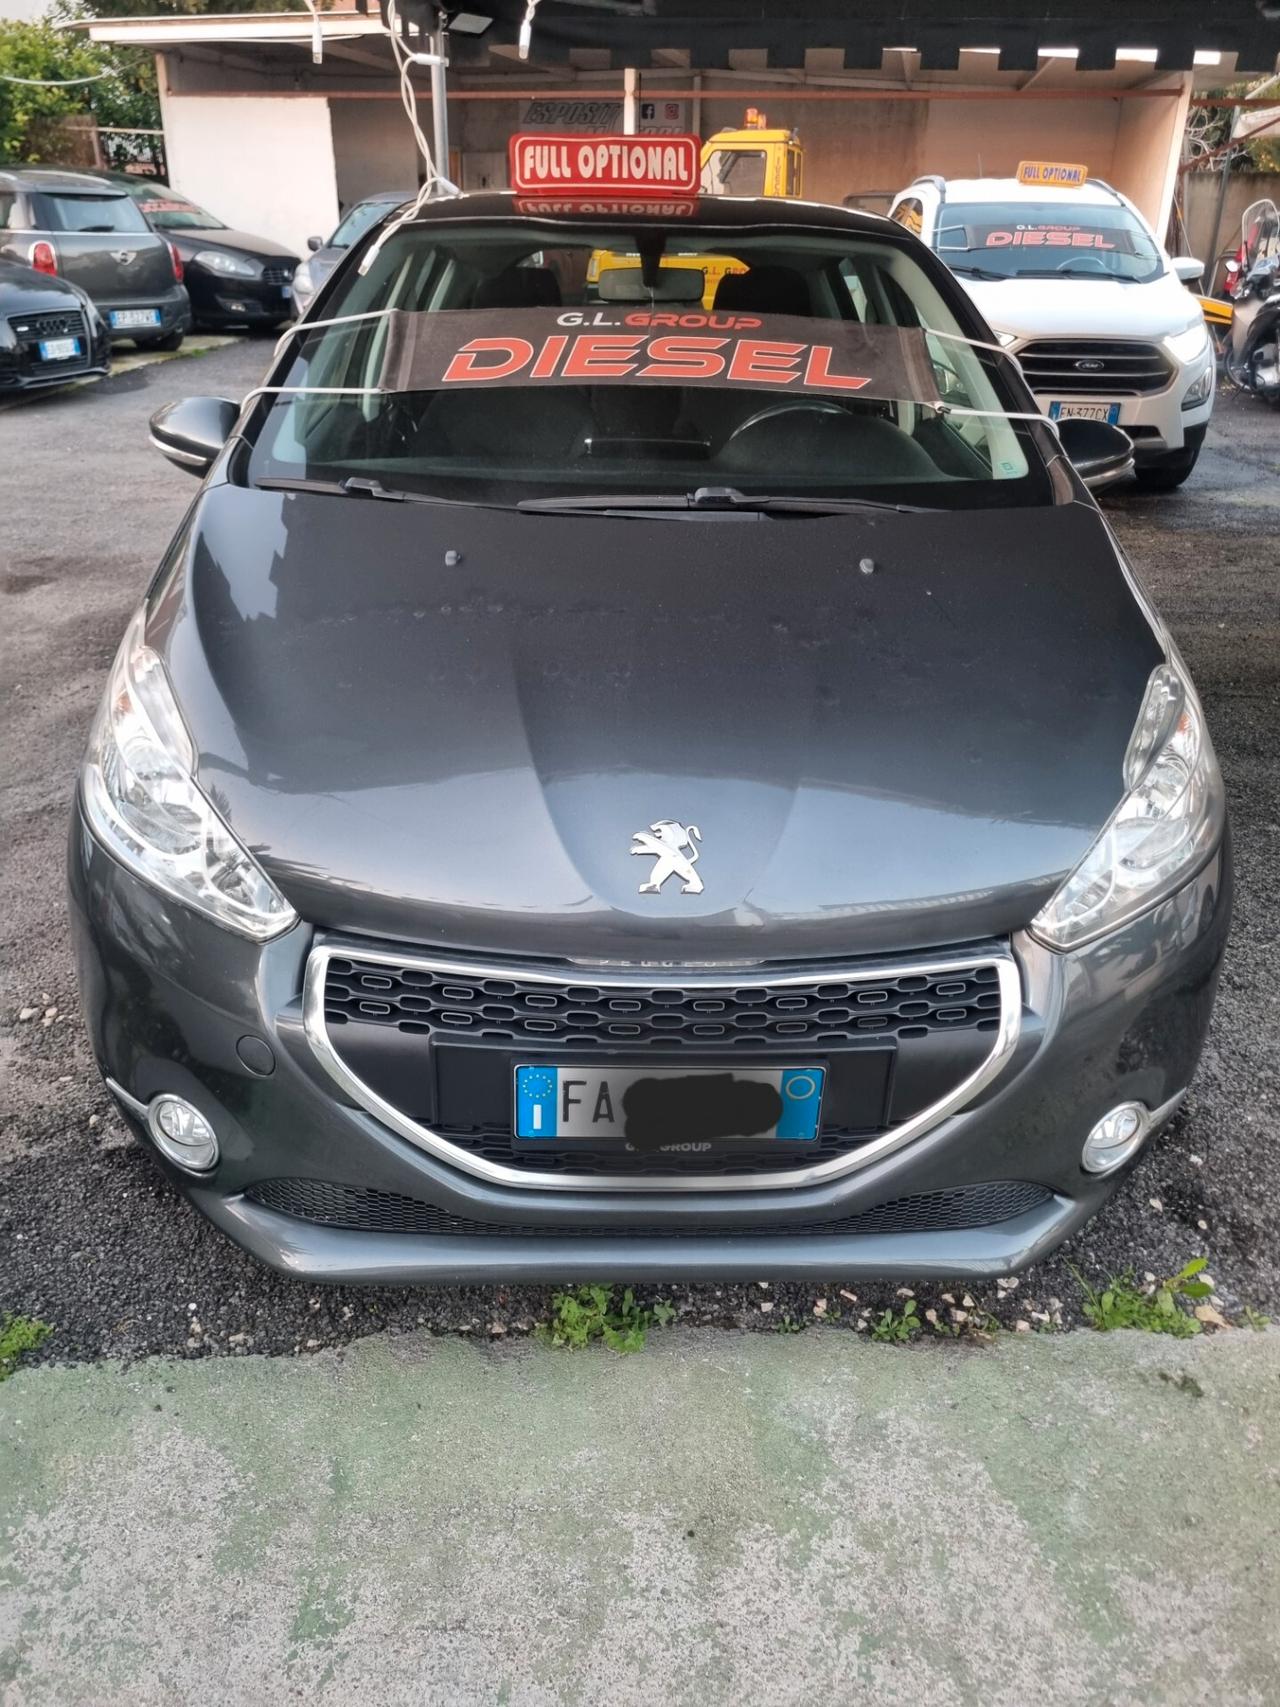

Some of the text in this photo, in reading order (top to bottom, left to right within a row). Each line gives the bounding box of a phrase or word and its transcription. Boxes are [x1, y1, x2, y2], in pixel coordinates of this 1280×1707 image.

[523, 102, 621, 125] ESPOSIT
[523, 144, 688, 181] FULL OPTIONAL
[1024, 166, 1081, 182] FULL OPTIONAL
[985, 231, 1115, 249] DIESEL
[441, 334, 872, 390] DIESEL
